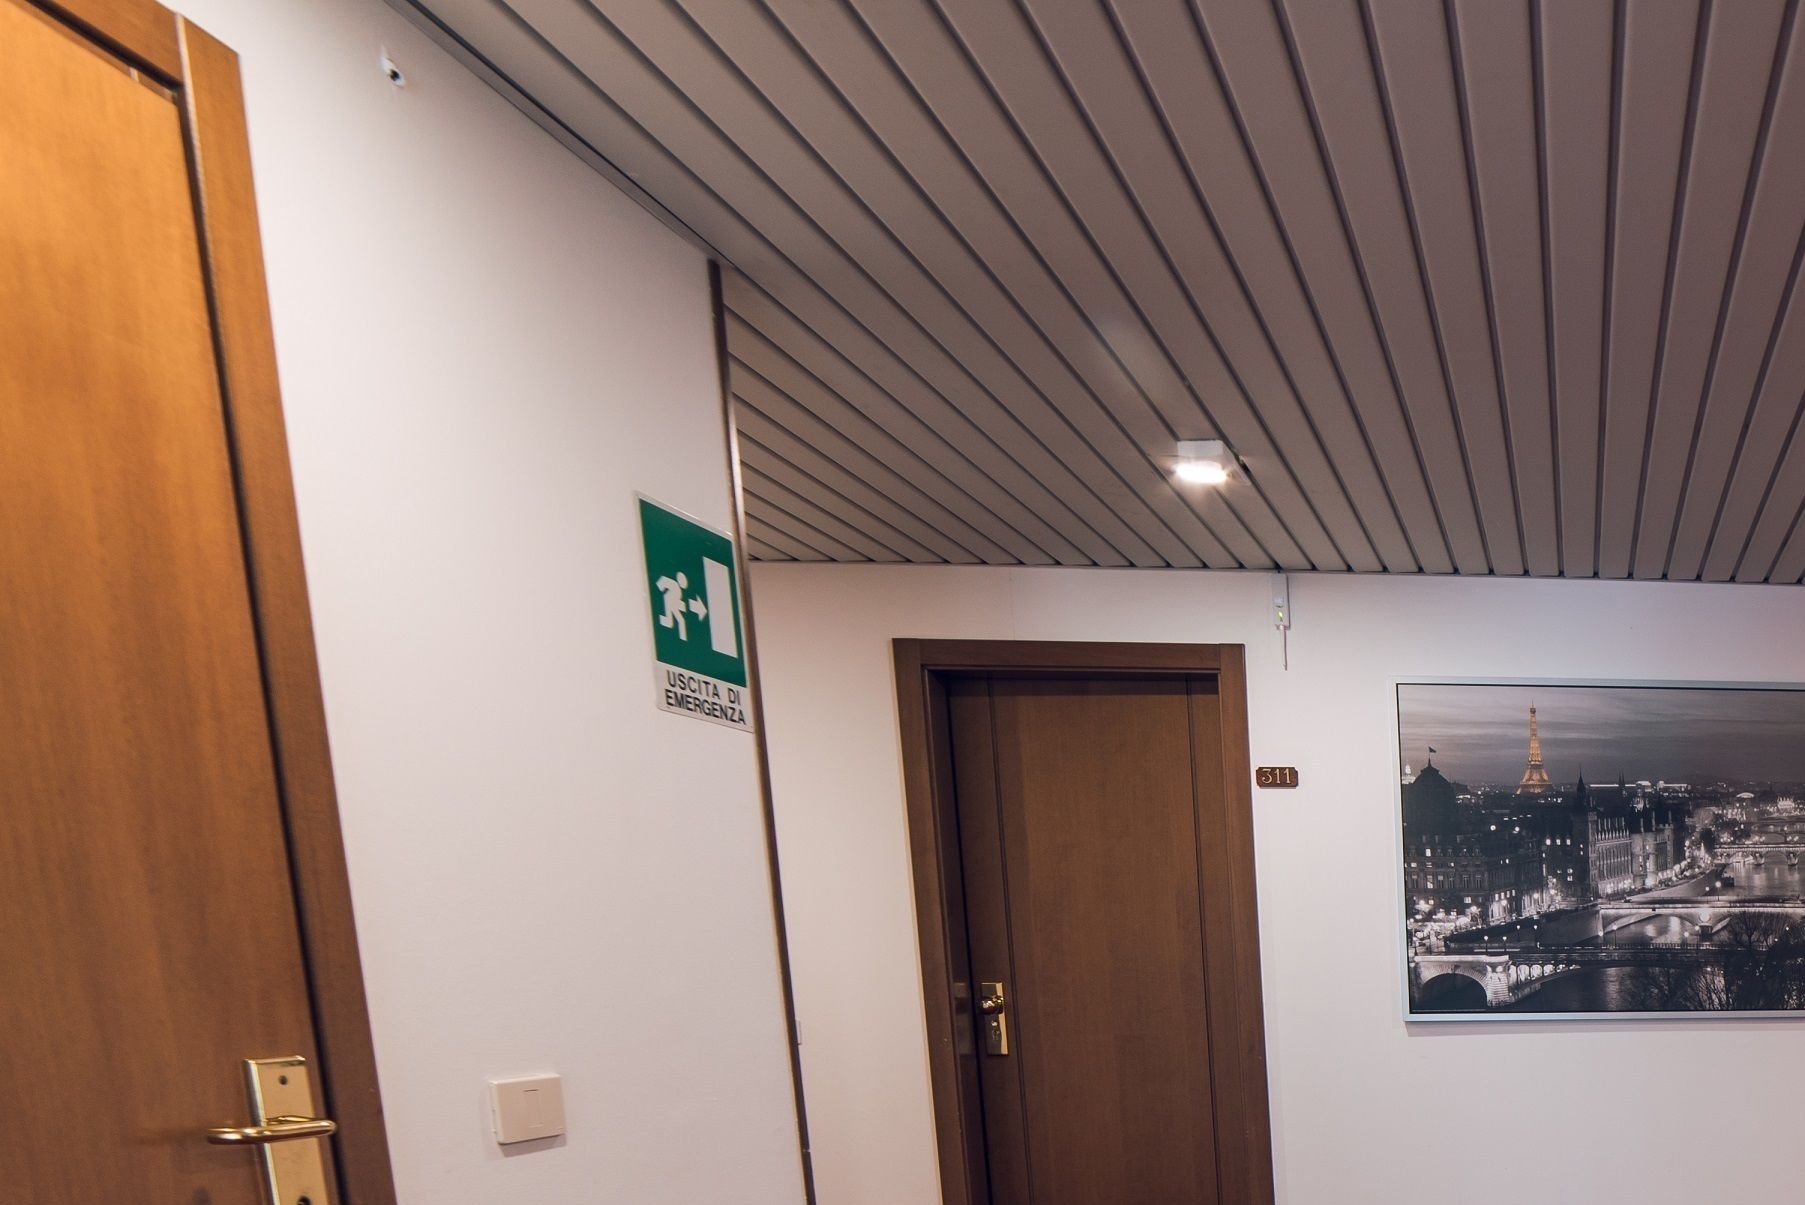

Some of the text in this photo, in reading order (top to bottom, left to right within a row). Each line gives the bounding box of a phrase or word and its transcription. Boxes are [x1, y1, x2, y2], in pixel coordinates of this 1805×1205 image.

[667, 670, 741, 706] USCITA DI
[665, 688, 746, 725] EMERGENZA
[1261, 768, 1291, 784] 311
